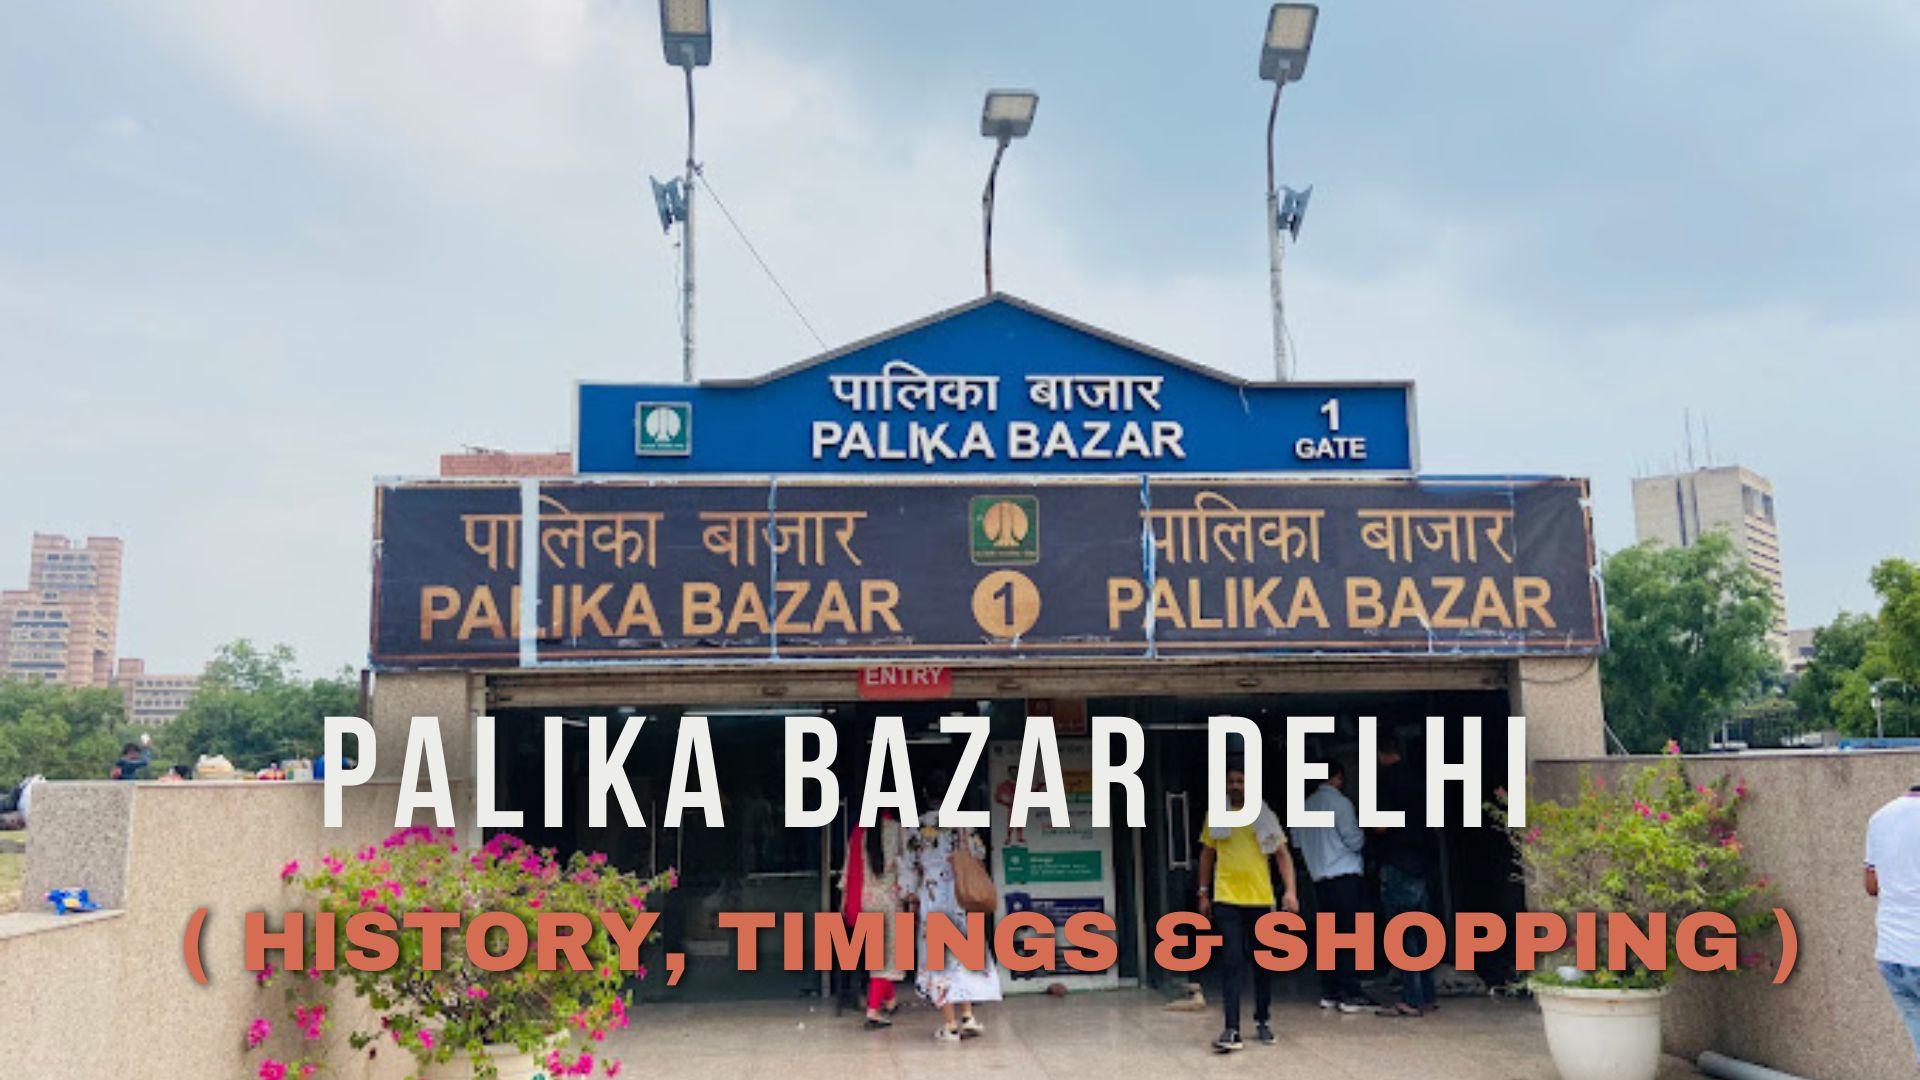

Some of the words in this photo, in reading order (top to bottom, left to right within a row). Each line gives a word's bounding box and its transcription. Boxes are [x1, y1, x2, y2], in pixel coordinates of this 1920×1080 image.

[829, 360, 1000, 411] पालिका
[1025, 375, 1164, 410] बाजार
[1320, 398, 1339, 431] 1
[811, 421, 996, 464] PALIKA
[1008, 421, 1186, 459] BAZAR
[1295, 437, 1367, 459] GATE
[699, 510, 867, 567] बाजार
[1357, 508, 1514, 563] बाजार
[419, 580, 662, 641] PALIKA
[682, 578, 902, 636] BAZAR
[993, 581, 1014, 626] 1
[1107, 576, 1331, 631] PALIKA
[1345, 575, 1557, 629] BAZAR
[865, 666, 944, 686] ENTRY
